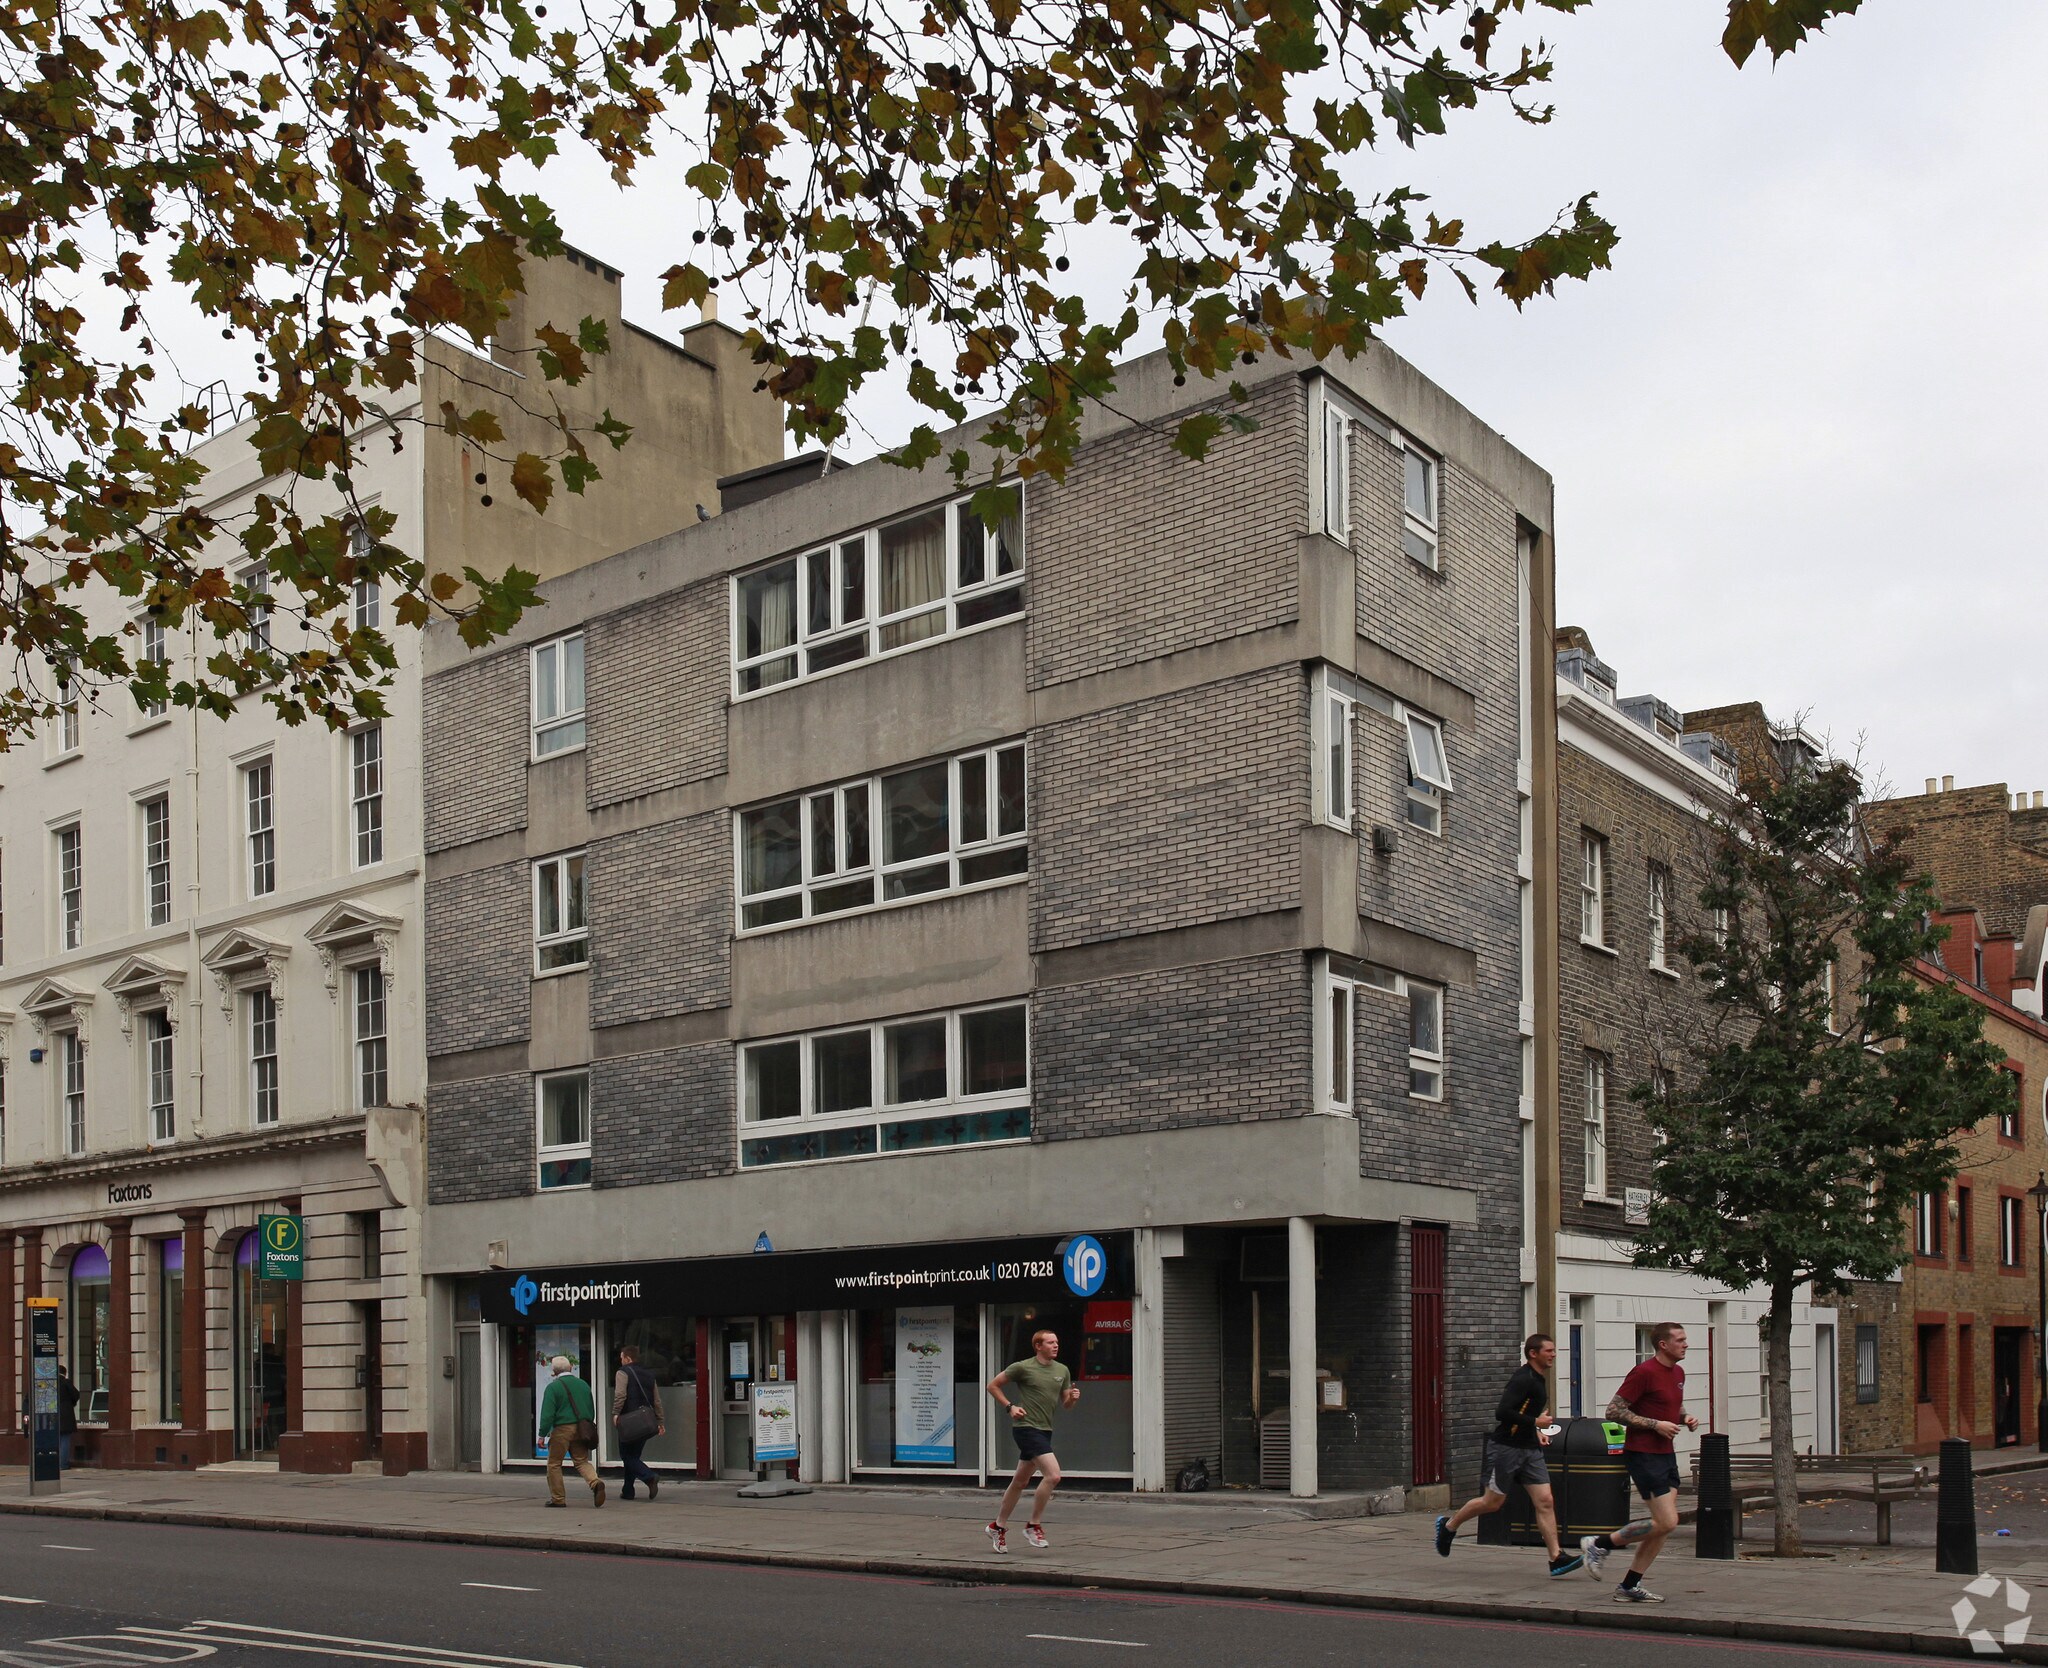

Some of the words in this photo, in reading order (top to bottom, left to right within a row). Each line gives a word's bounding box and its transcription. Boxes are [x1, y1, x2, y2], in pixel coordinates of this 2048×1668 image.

[108, 1183, 152, 1204] Foxtons
[276, 1223, 289, 1246] F
[266, 1252, 299, 1262] Foxtons
[835, 1265, 990, 1289] www.firstpointprint.co.uk
[998, 1263, 1020, 1280] 020
[1023, 1260, 1054, 1278] 7828
[540, 1279, 641, 1307] firstpointprint
